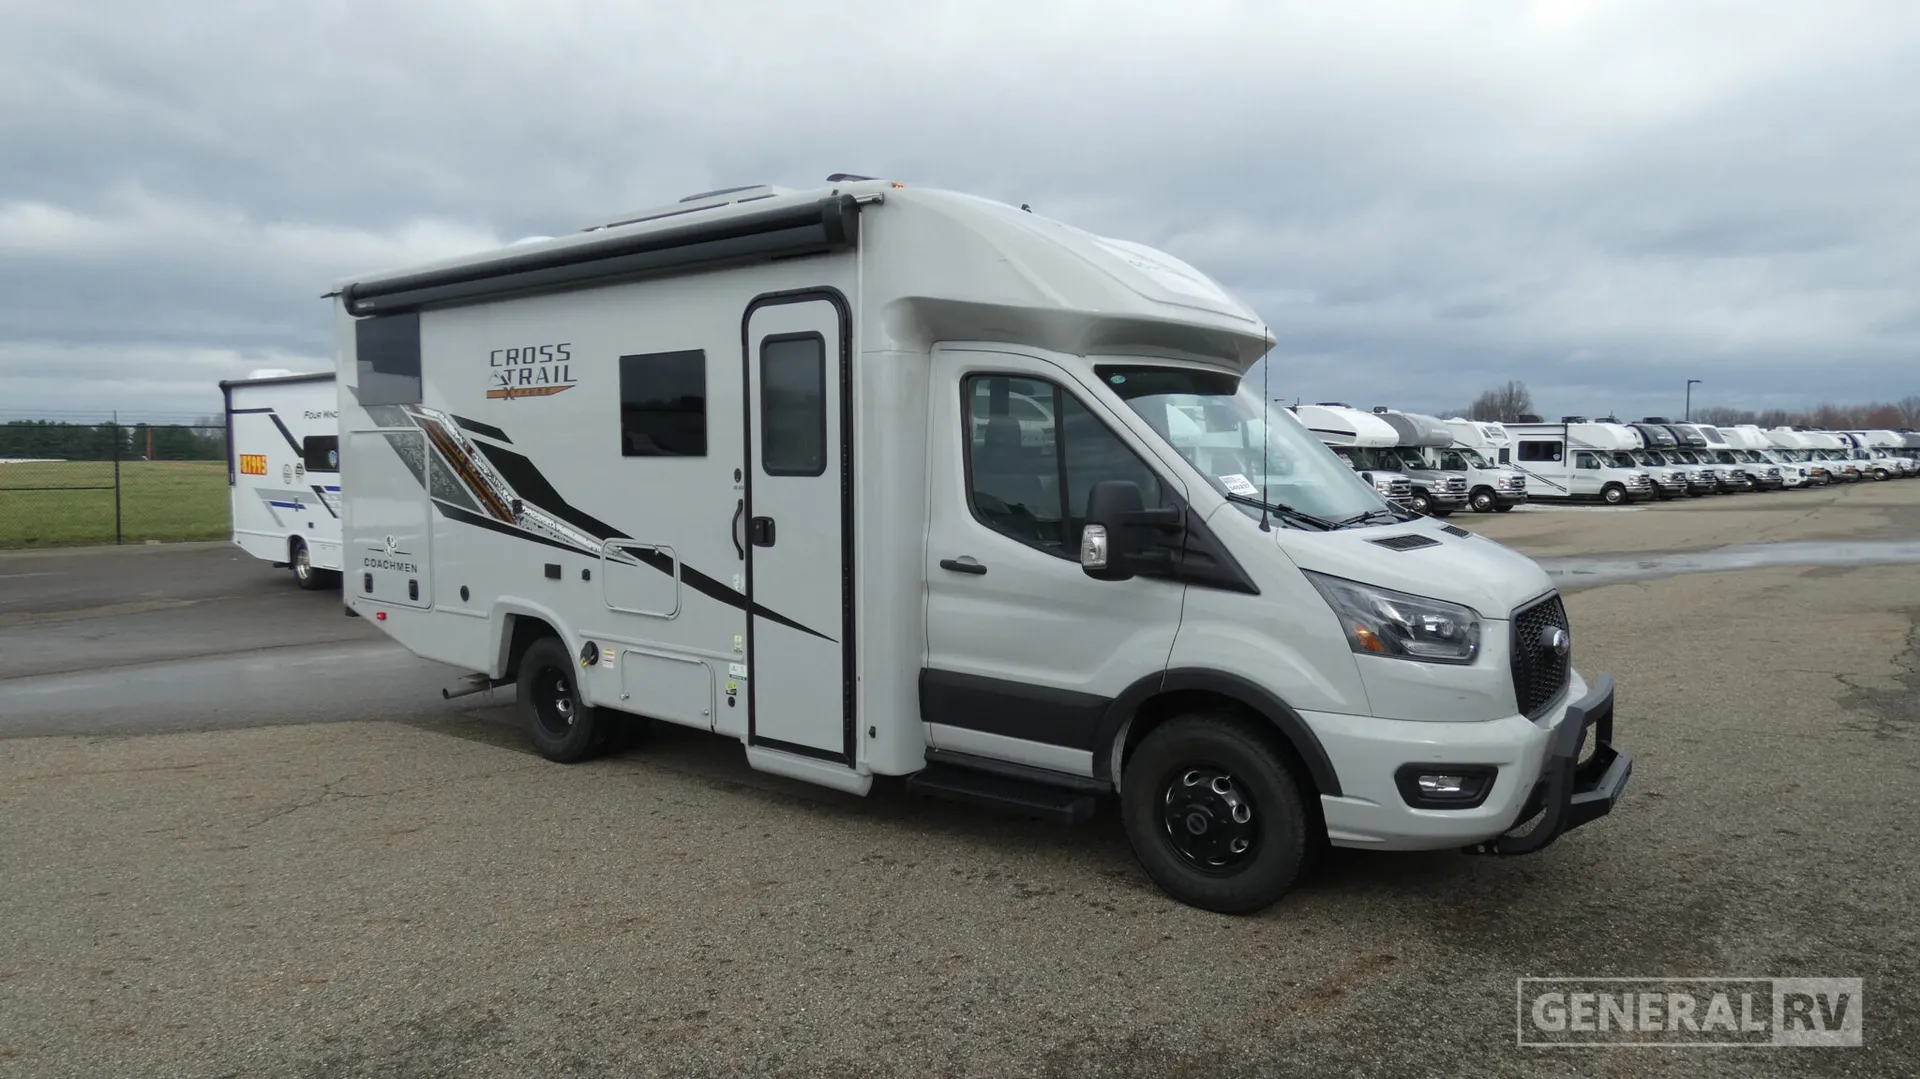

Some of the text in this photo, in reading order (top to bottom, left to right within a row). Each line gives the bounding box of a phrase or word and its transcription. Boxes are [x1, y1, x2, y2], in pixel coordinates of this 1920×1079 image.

[490, 342, 572, 367] CROSS
[503, 364, 578, 386] TRAIL
[363, 556, 419, 574] COACHMEN
